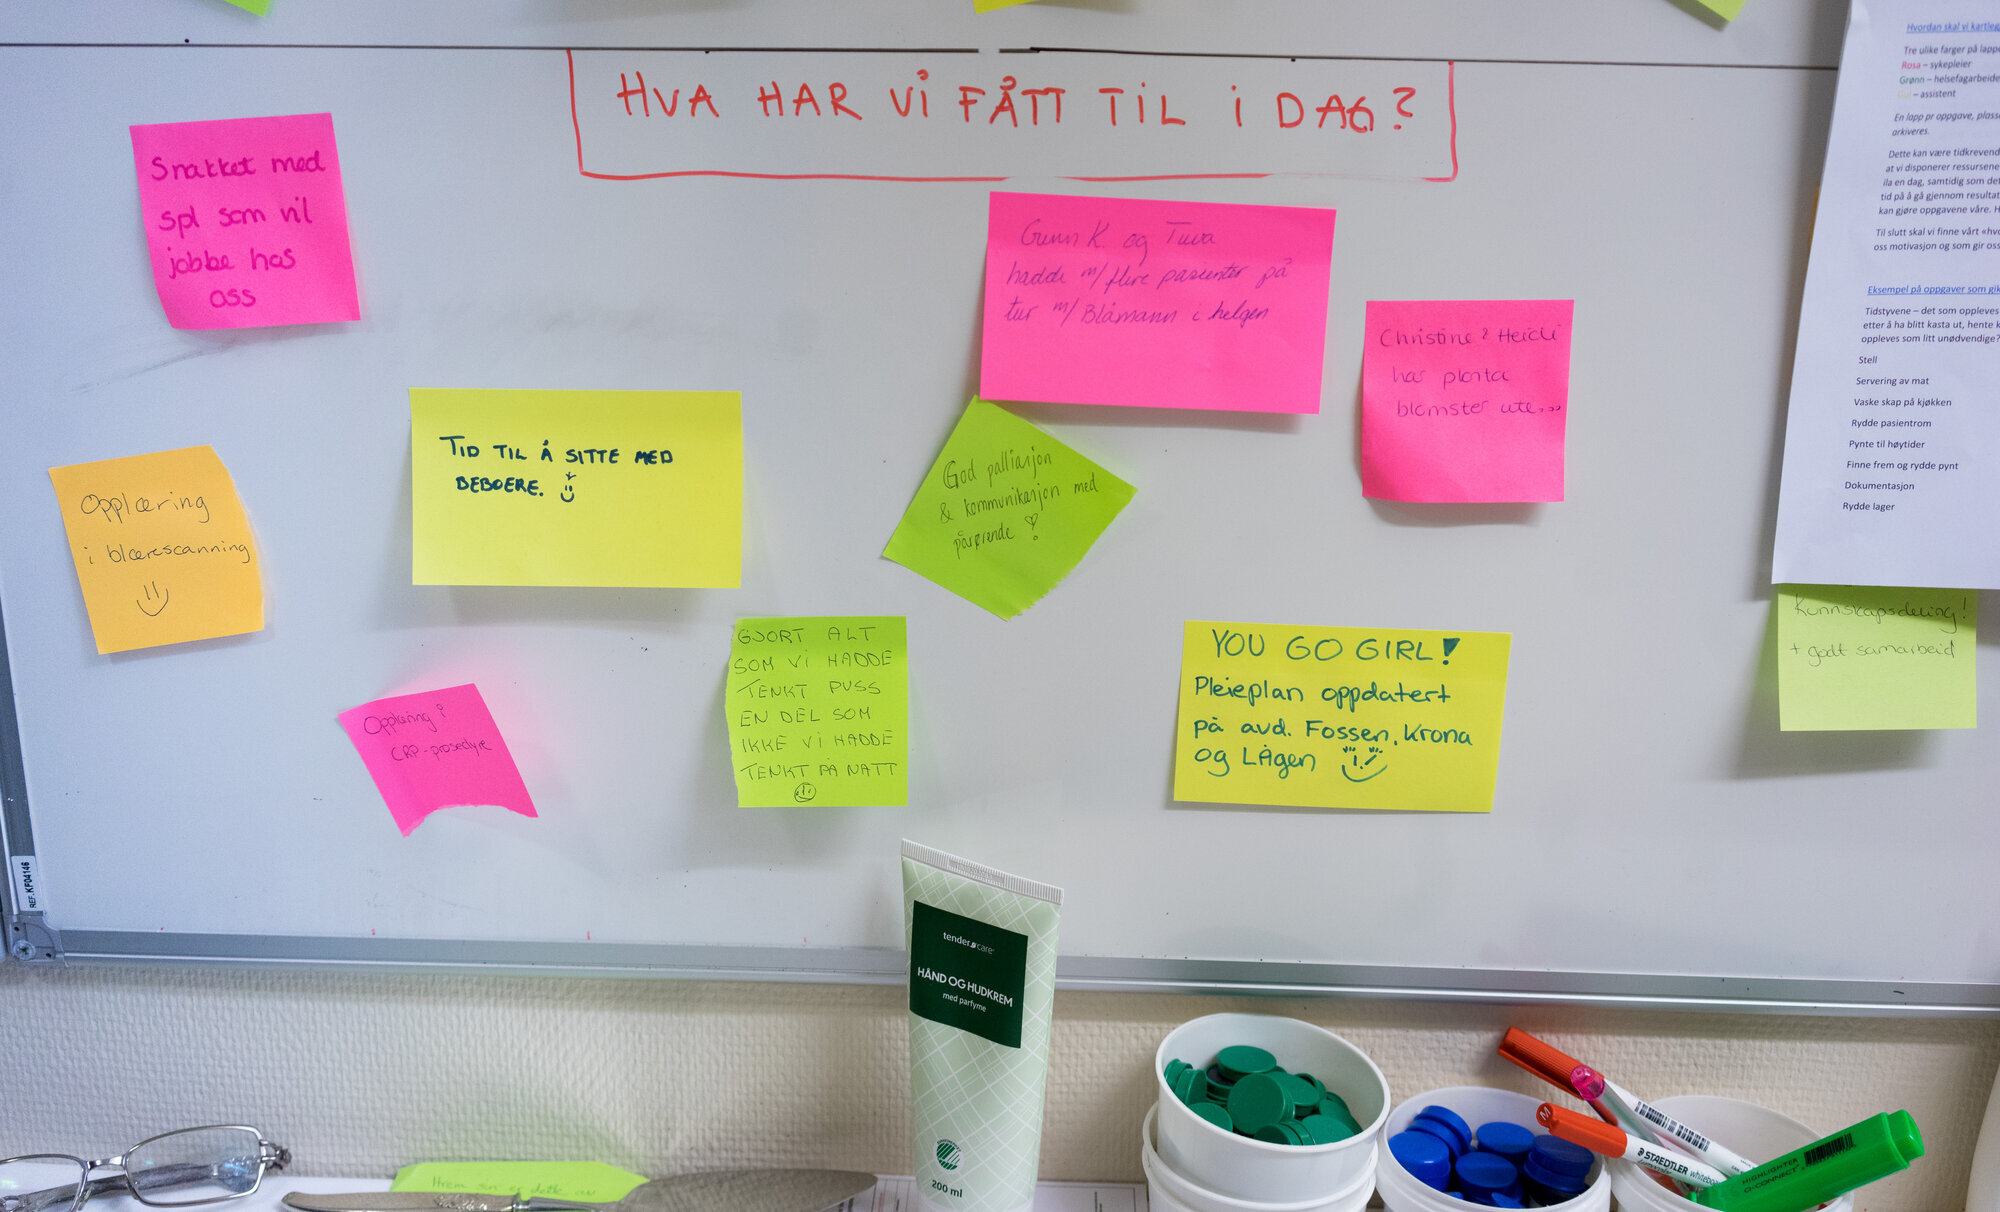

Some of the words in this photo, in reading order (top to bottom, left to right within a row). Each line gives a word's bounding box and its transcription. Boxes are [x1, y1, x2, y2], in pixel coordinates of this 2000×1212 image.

[1906, 23, 1942, 33] Hvordan
[1904, 46, 1917, 55] Tre
[1919, 45, 1938, 54] ulike
[1940, 45, 1965, 56] farger
[1901, 61, 1921, 69] Rosa
[1930, 60, 1972, 70] sykepleier
[1899, 76, 1925, 85] Grønn
[616, 71, 719, 117] HVA
[757, 81, 863, 120] HAR
[959, 75, 1066, 128] FÅTT
[1920, 89, 1956, 98] assistent
[1906, 112, 1923, 122] lapp
[272, 150, 327, 173] med
[1888, 150, 1911, 159] Dette
[1913, 148, 1927, 158] kan
[1929, 149, 1951, 157] være
[1905, 163, 1950, 173] disponerer
[1952, 163, 2000, 171] ressursene
[1927, 177, 1964, 187] samtidig
[1926, 191, 1964, 202] gjennom
[218, 207, 266, 228] som
[280, 196, 313, 224] vil
[1895, 206, 1918, 217] gjøre
[1920, 206, 1968, 216] oppgavene
[1888, 228, 1906, 237] slutt
[1908, 227, 1926, 236] skal
[1937, 227, 1959, 236] finne
[1962, 226, 1979, 236] vårt
[1122, 231, 1149, 267] og
[1889, 241, 1937, 252] motivasjon
[167, 246, 236, 279] jobbe
[250, 248, 297, 271] hos
[1006, 260, 1067, 287] hadde
[1156, 264, 1250, 290] pasienter
[1255, 257, 1294, 290] på
[209, 288, 257, 308] oss
[1867, 285, 1909, 296] Eksempel
[1923, 285, 1965, 295] oppgaver
[1004, 295, 1039, 322] tur
[1208, 299, 1269, 328] helgen
[1865, 307, 1912, 317] Tidstyvene
[1959, 306, 1999, 316] oppleves
[1863, 321, 1885, 329] etter
[1907, 320, 1925, 329] blitt
[1927, 320, 1950, 329] kasta
[1967, 320, 1994, 329] hente
[1379, 327, 1474, 348] Christine
[1861, 334, 1900, 344] oppleves
[1858, 355, 1878, 365] Stell
[1392, 365, 1426, 384] har
[1856, 376, 1897, 387] Servering
[1911, 377, 1930, 385] mat
[1396, 400, 1489, 417] blomster
[1854, 398, 1879, 407] Vaske
[1881, 398, 1902, 408] skap
[1904, 397, 1915, 408] på
[1917, 397, 1952, 408] kjøkken
[1851, 419, 1879, 429] Rydde
[1880, 419, 1932, 429] pasientrom
[493, 444, 528, 461] TIL
[540, 439, 554, 463] Å
[565, 448, 620, 465] SITTE
[634, 449, 674, 466] MED
[1849, 440, 1874, 450] Pynte
[1876, 440, 1885, 448] til
[1887, 440, 1926, 450] høytider
[942, 458, 977, 490] God
[1846, 460, 1871, 469] Finne
[1873, 460, 1895, 469] frem
[1897, 462, 1908, 472] og
[1910, 461, 1936, 472] rydde
[1938, 461, 1959, 472] pynt
[1073, 471, 1099, 496] med
[1844, 481, 1915, 492] Dokumentasjon
[80, 491, 211, 524] Opplæring
[1842, 502, 1870, 512] Rydde
[1872, 502, 1895, 512] lager
[84, 546, 94, 565] i
[737, 627, 805, 645] GJORT
[827, 626, 877, 641] ALT
[1212, 628, 1265, 658] YOU
[1286, 635, 1343, 662] GO
[734, 656, 775, 675] SOM
[827, 650, 893, 668] HADDE
[1807, 642, 1848, 668] godt
[1855, 639, 1956, 659] samarbeid
[736, 678, 808, 699] TENKT
[829, 680, 881, 695] PUSS
[1194, 675, 1304, 707] Pleieplan
[1321, 681, 1451, 713] oppdatert
[740, 710, 768, 728] EN
[780, 707, 821, 724] DEL
[832, 706, 872, 721] SOM
[1194, 716, 1224, 738] på
[1240, 718, 1292, 737] avd.
[742, 735, 787, 753] IKKE
[834, 730, 893, 747] HADDE
[740, 762, 810, 781] TENKT
[819, 757, 838, 777] PÅ
[847, 762, 898, 777] NATT
[1194, 748, 1231, 777] og
[917, 966, 947, 985] HÅND
[948, 976, 966, 990] OG
[967, 982, 1014, 1008] HUDKREM
[942, 991, 958, 1002] med
[959, 995, 987, 1013] parfyme
[1540, 1106, 1551, 1120] M
[1643, 1150, 1689, 1177] STAEDTLER
[1742, 1158, 1799, 1185] HIGHLIGHTER
[931, 1179, 949, 1193] 200
[950, 1188, 963, 1198] ml
